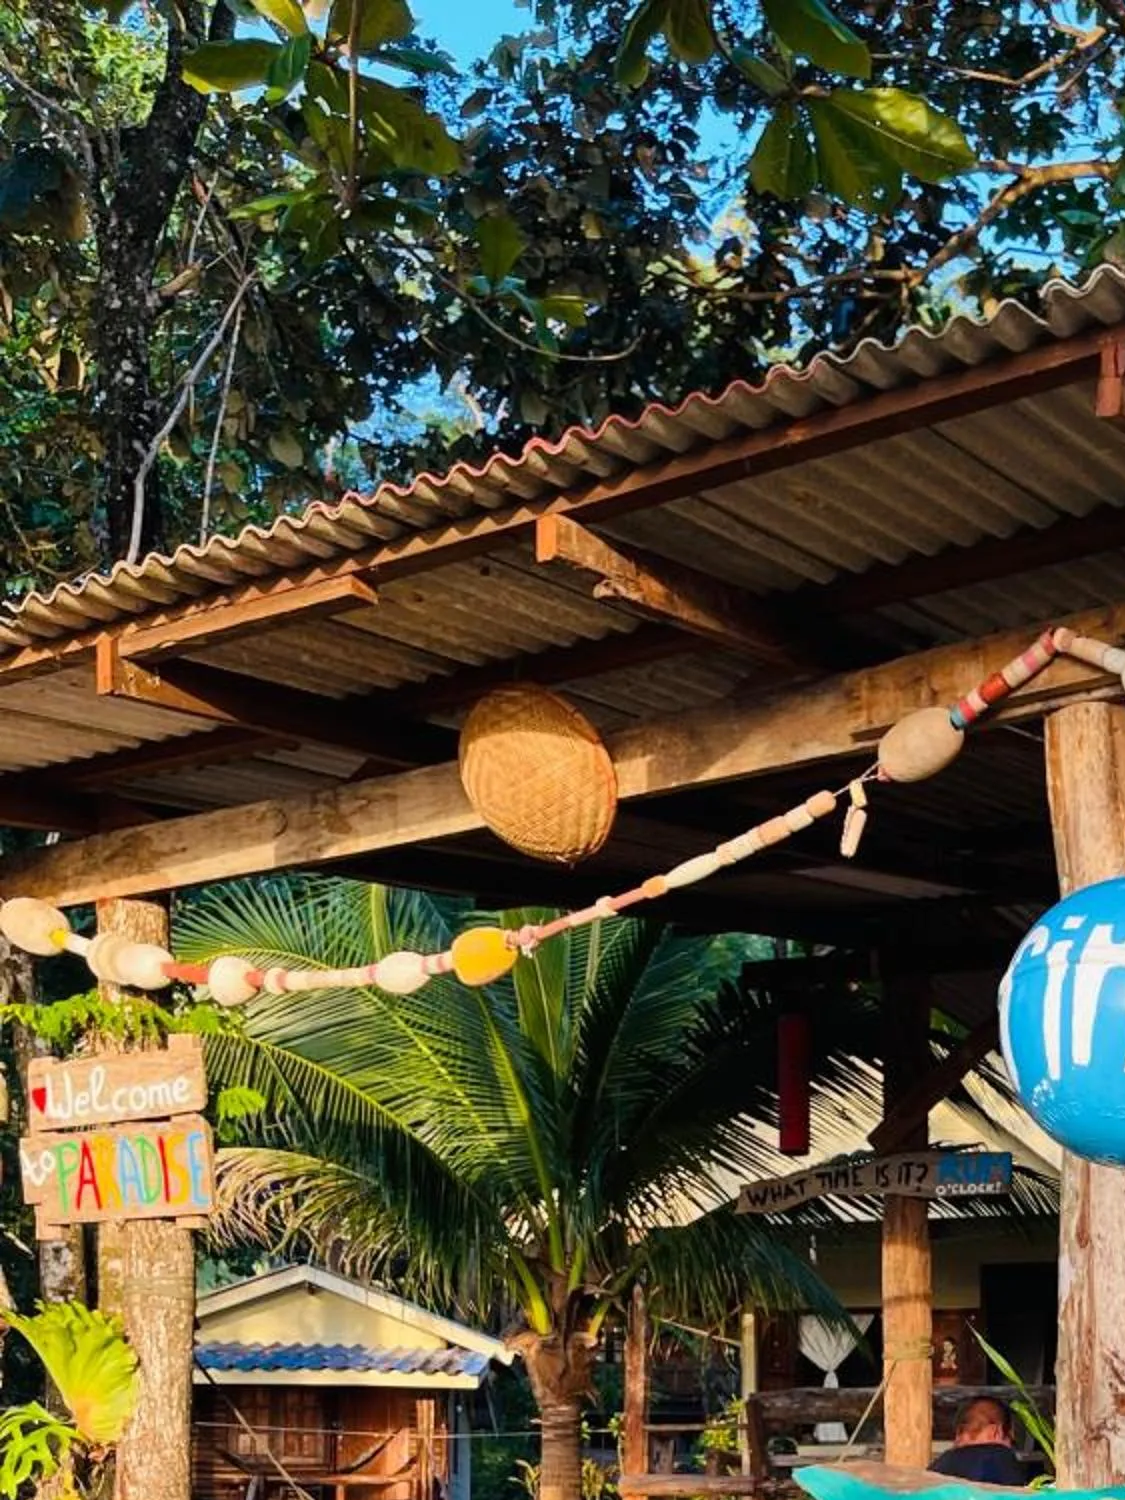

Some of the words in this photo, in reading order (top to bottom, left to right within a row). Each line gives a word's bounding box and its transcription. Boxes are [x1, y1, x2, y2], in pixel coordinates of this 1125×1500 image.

[44, 1065, 191, 1119] Welcome
[20, 1145, 54, 1187] to
[56, 1132, 209, 1216] PARADISE
[747, 1178, 807, 1206] WHAT
[815, 1165, 863, 1190] TIME
[875, 1163, 889, 1188] IS
[898, 1162, 928, 1192] IT?
[935, 1181, 1002, 1196] O'CLOCK!
